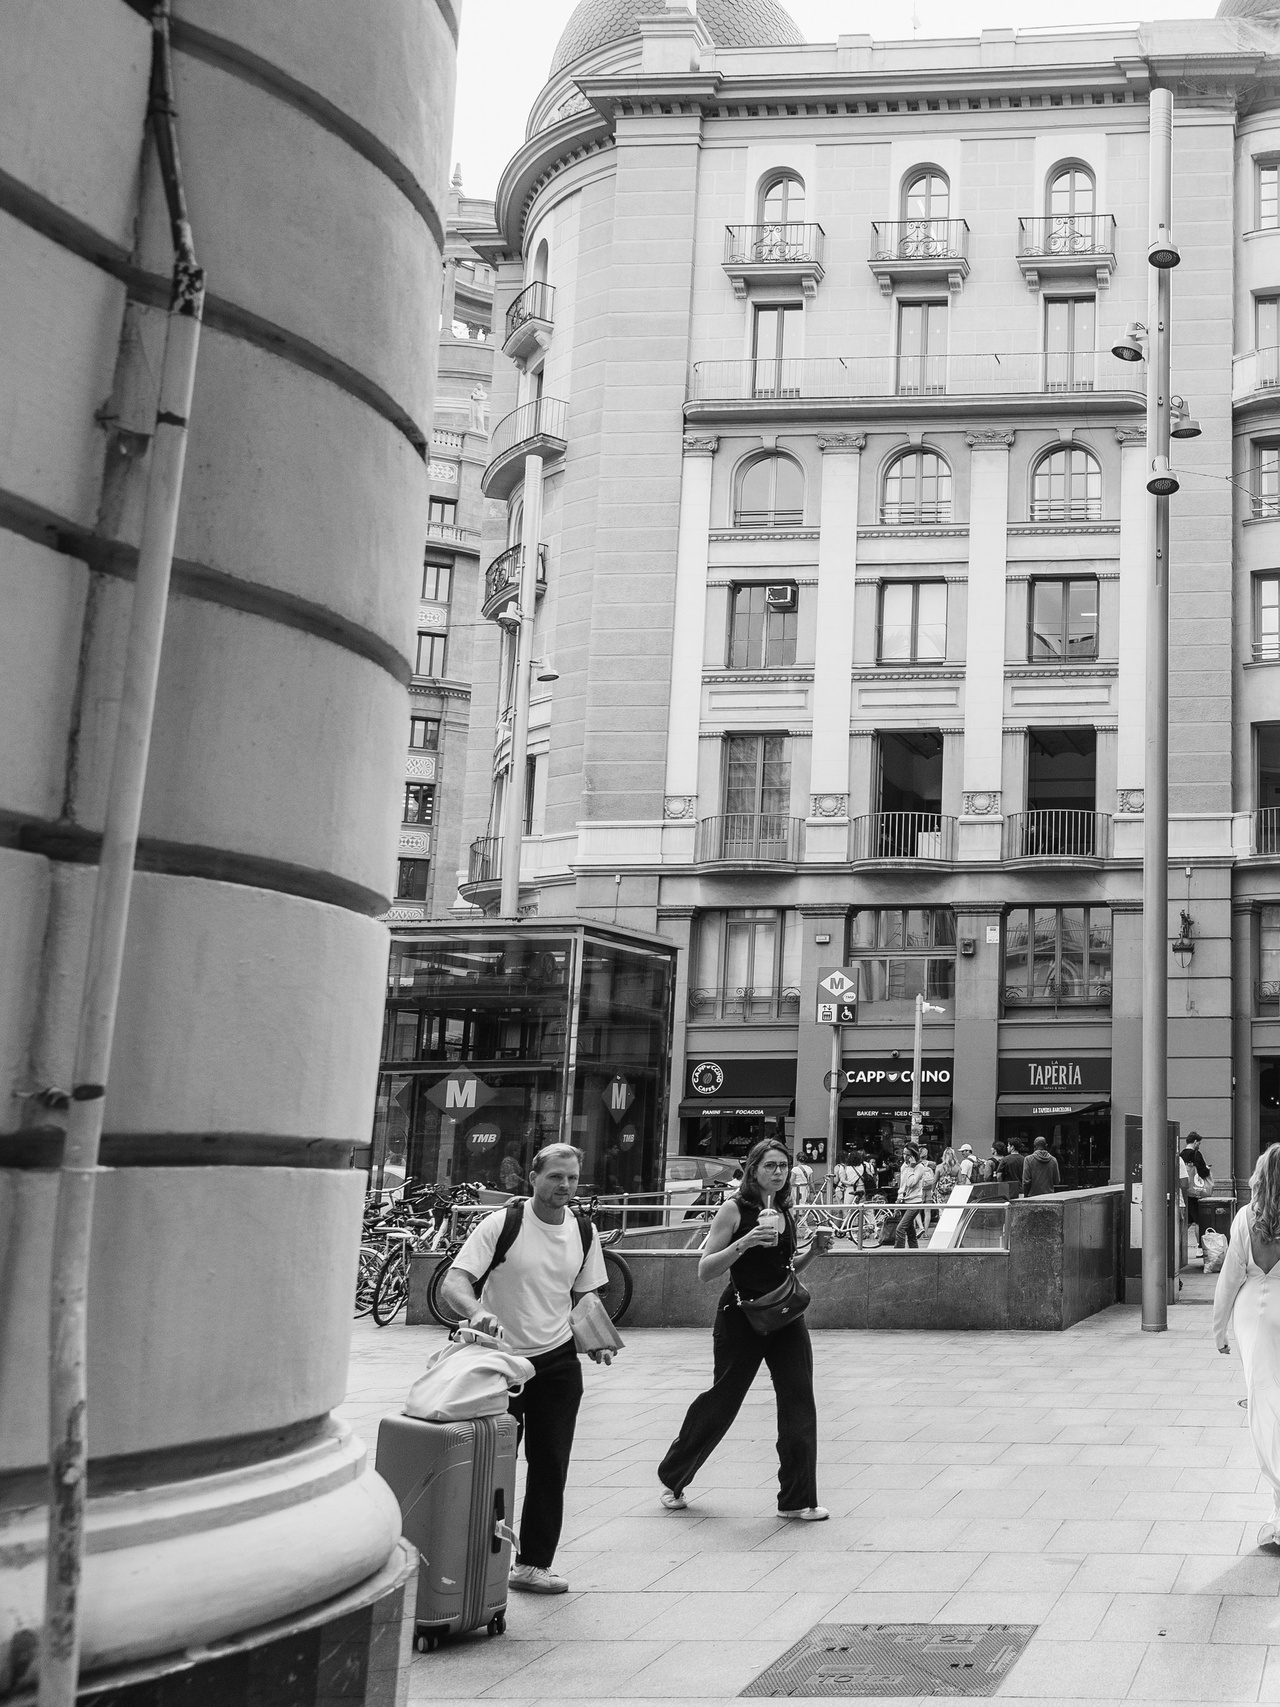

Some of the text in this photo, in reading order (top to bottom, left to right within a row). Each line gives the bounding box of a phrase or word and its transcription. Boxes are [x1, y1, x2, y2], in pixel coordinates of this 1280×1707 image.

[830, 977, 844, 990] M
[445, 1080, 477, 1108] M
[610, 1082, 627, 1110] M
[471, 1133, 498, 1143] TMB
[622, 1133, 635, 1143] TMB
